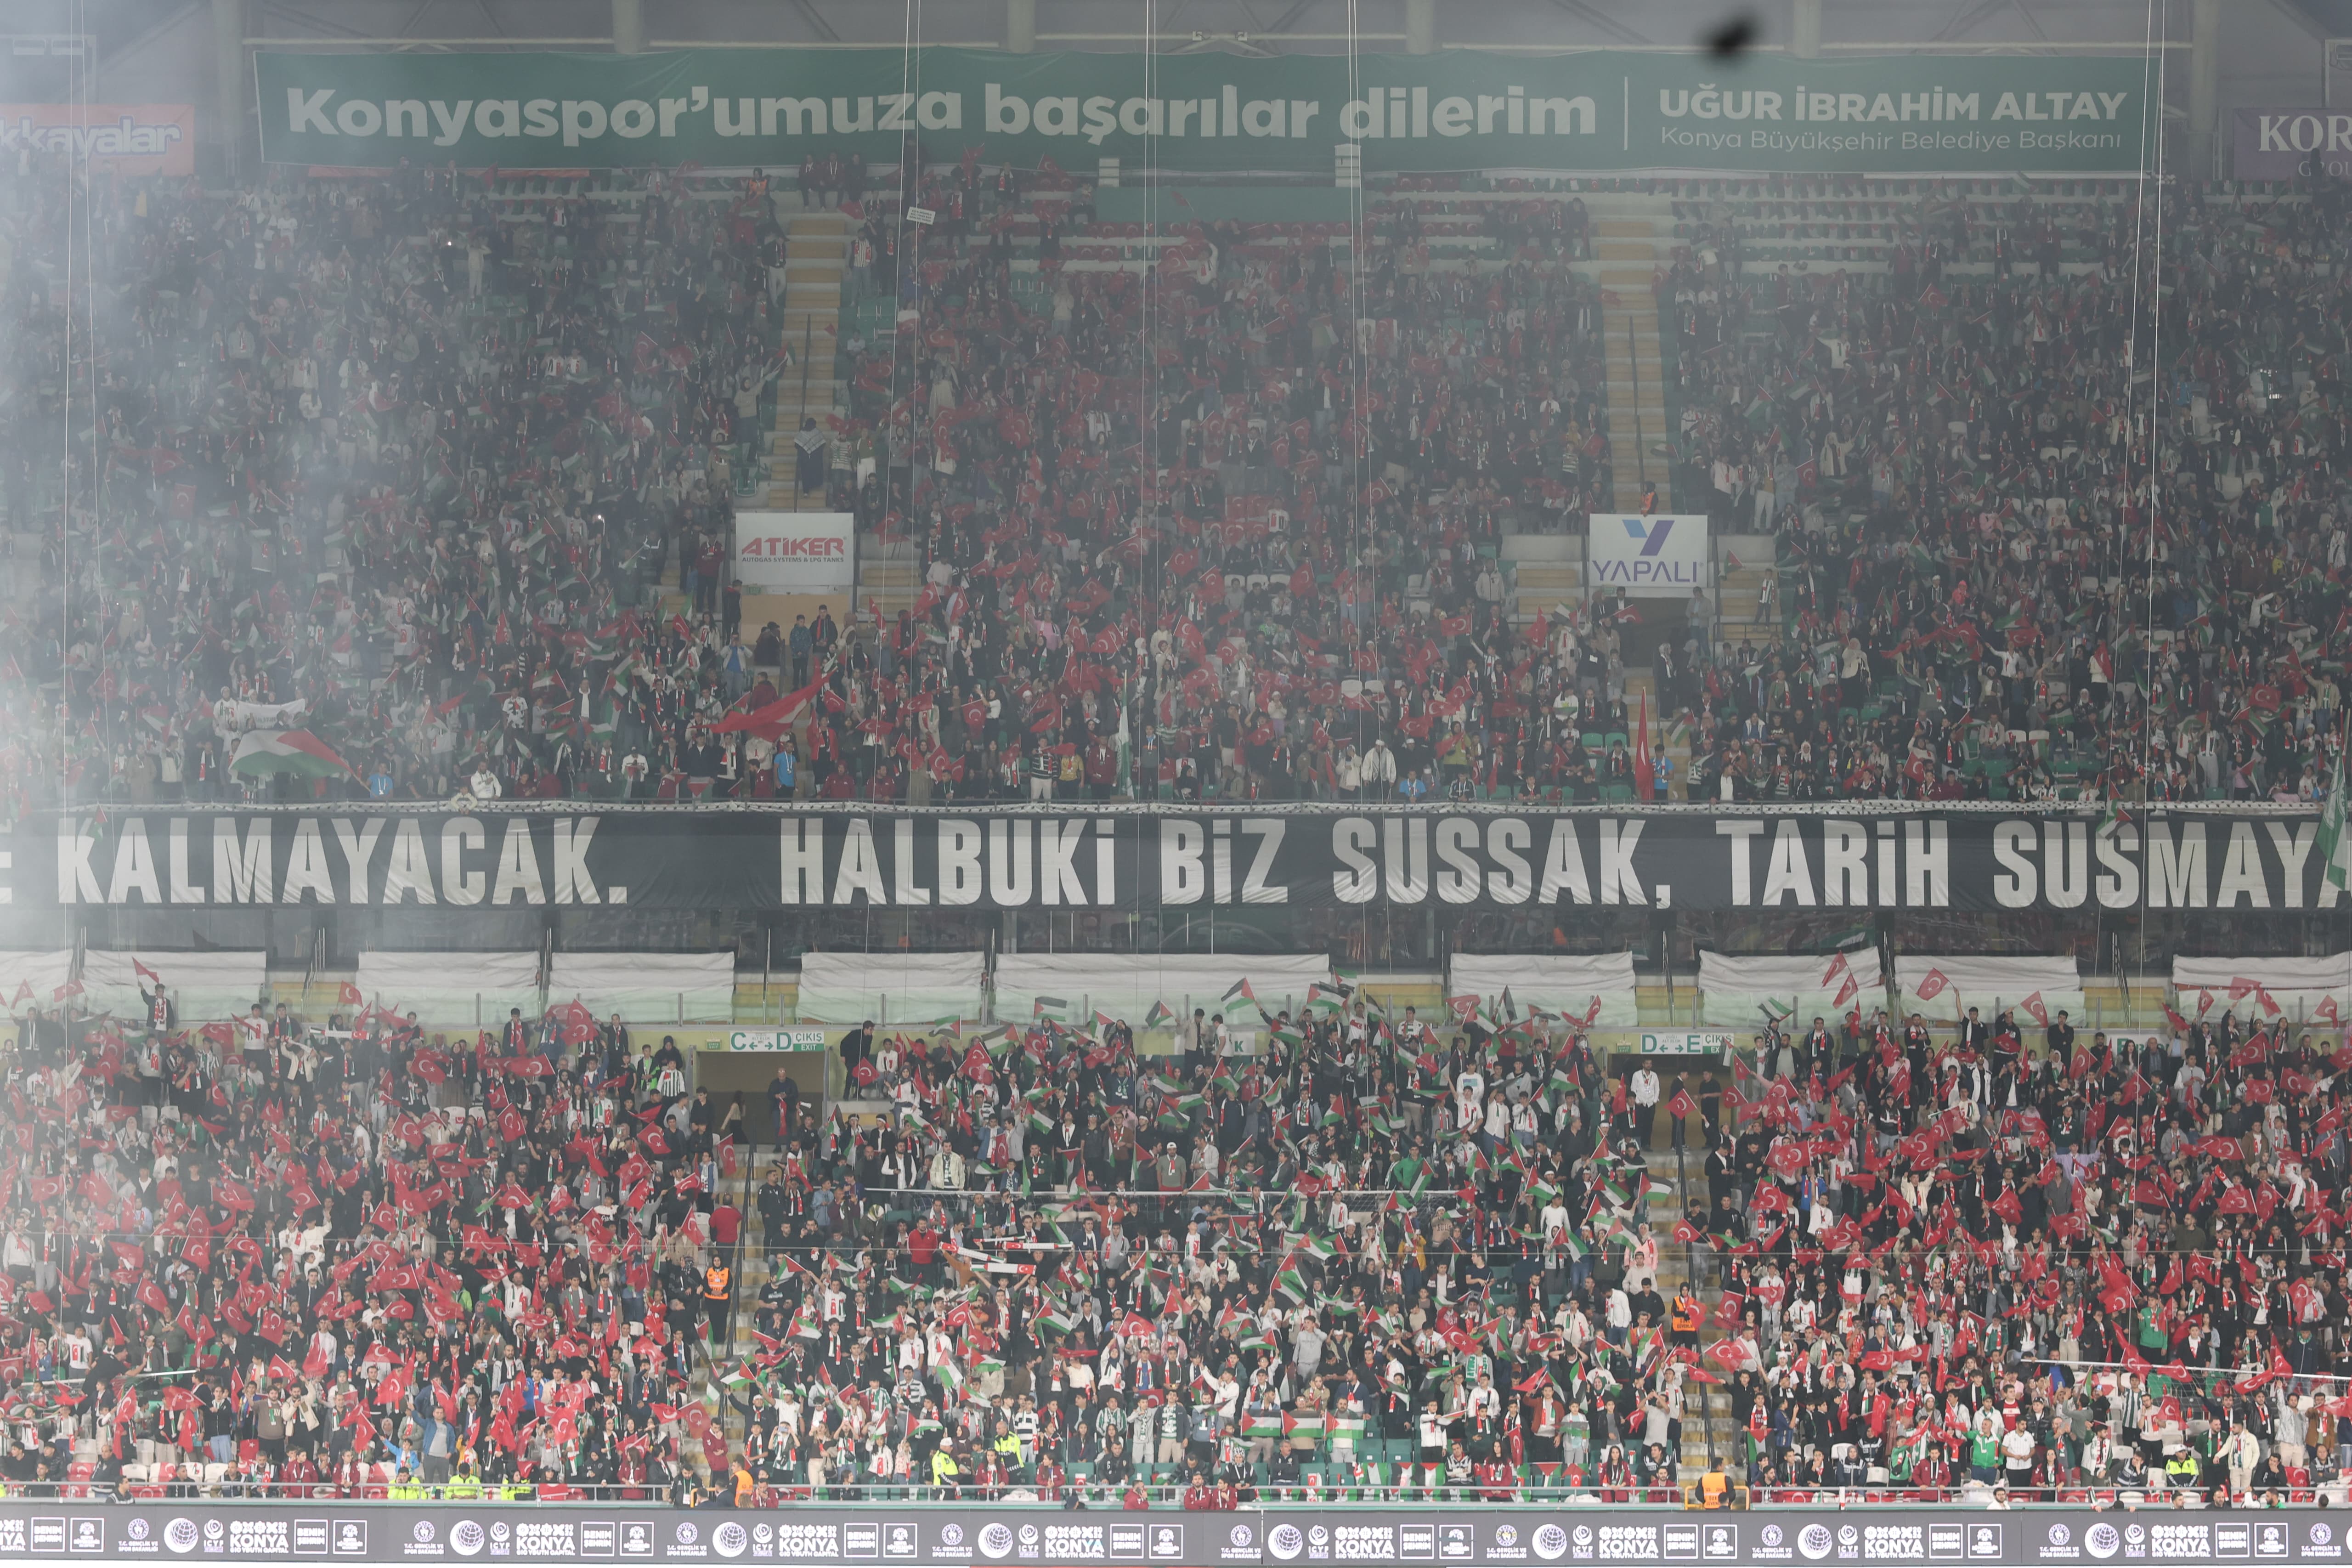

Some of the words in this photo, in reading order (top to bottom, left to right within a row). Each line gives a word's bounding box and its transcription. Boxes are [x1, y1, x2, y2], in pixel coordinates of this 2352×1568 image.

[1660, 83, 1782, 120] UĞUR
[1796, 85, 1979, 122] İBRAHİM
[1991, 92, 2127, 120] ALTAY
[985, 83, 1319, 145] başarılar
[1340, 85, 1596, 139] dilerim
[1662, 127, 1741, 150] Konya
[1751, 130, 1894, 153] Büyükşehir
[1902, 130, 2010, 152] Belediye
[2019, 130, 2121, 151] Başkanı
[1592, 560, 1697, 583] YAPALI
[58, 817, 628, 906] KALMAYACAK.
[1333, 817, 1671, 910] SUSSAK,
[731, 1032, 746, 1050] C
[776, 1032, 792, 1050] D
[796, 1033, 822, 1042] ÇIKIŞ
[1641, 1035, 1657, 1053] D
[1687, 1035, 1701, 1053] E
[229, 1534, 289, 1547] KONYA
[516, 1537, 576, 1550] KONYA
[779, 1538, 839, 1551] KONYA
[1045, 1539, 1104, 1552] KONYA
[1335, 1540, 1395, 1553] KONYA
[1599, 1540, 1658, 1553] KONYA
[1864, 1540, 1924, 1553] KONYA
[2151, 1538, 2211, 1551] KONYA
